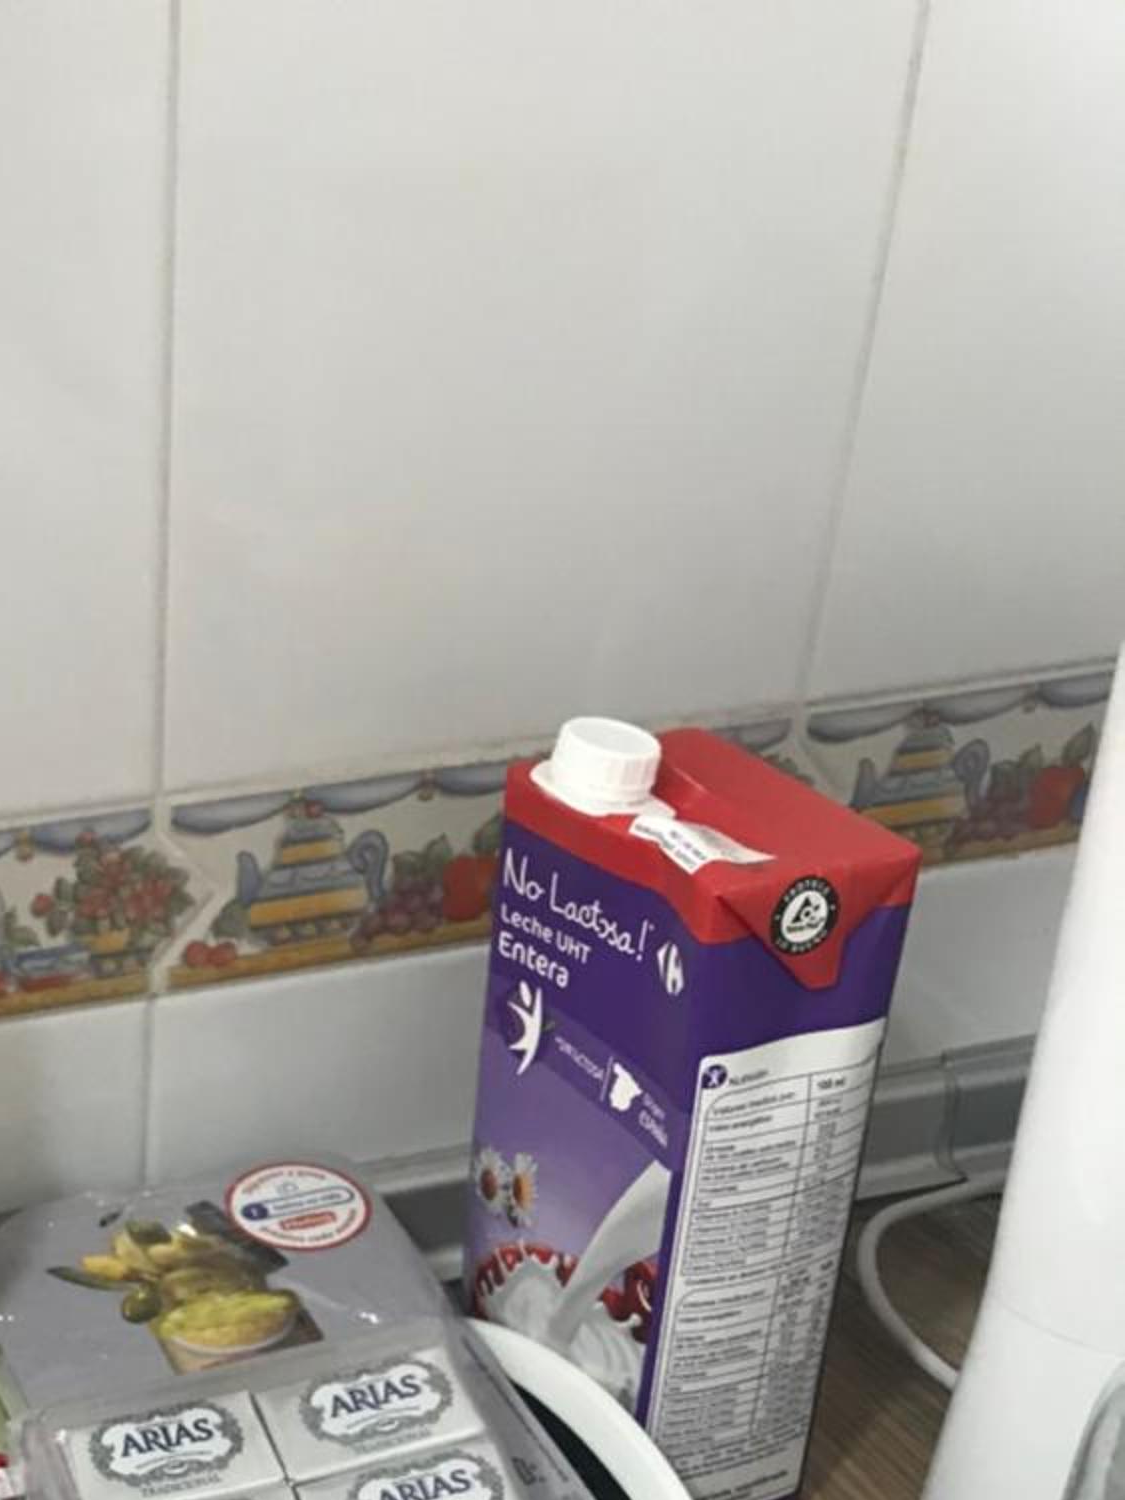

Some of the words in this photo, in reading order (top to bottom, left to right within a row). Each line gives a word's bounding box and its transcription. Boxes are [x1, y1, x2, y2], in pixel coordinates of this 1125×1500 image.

[503, 847, 545, 900] No
[497, 930, 571, 989] Entera
[500, 903, 552, 943] Leche
[555, 930, 593, 964] UHT
[330, 1373, 423, 1419] ARIAS
[121, 1417, 215, 1458] ARIAS
